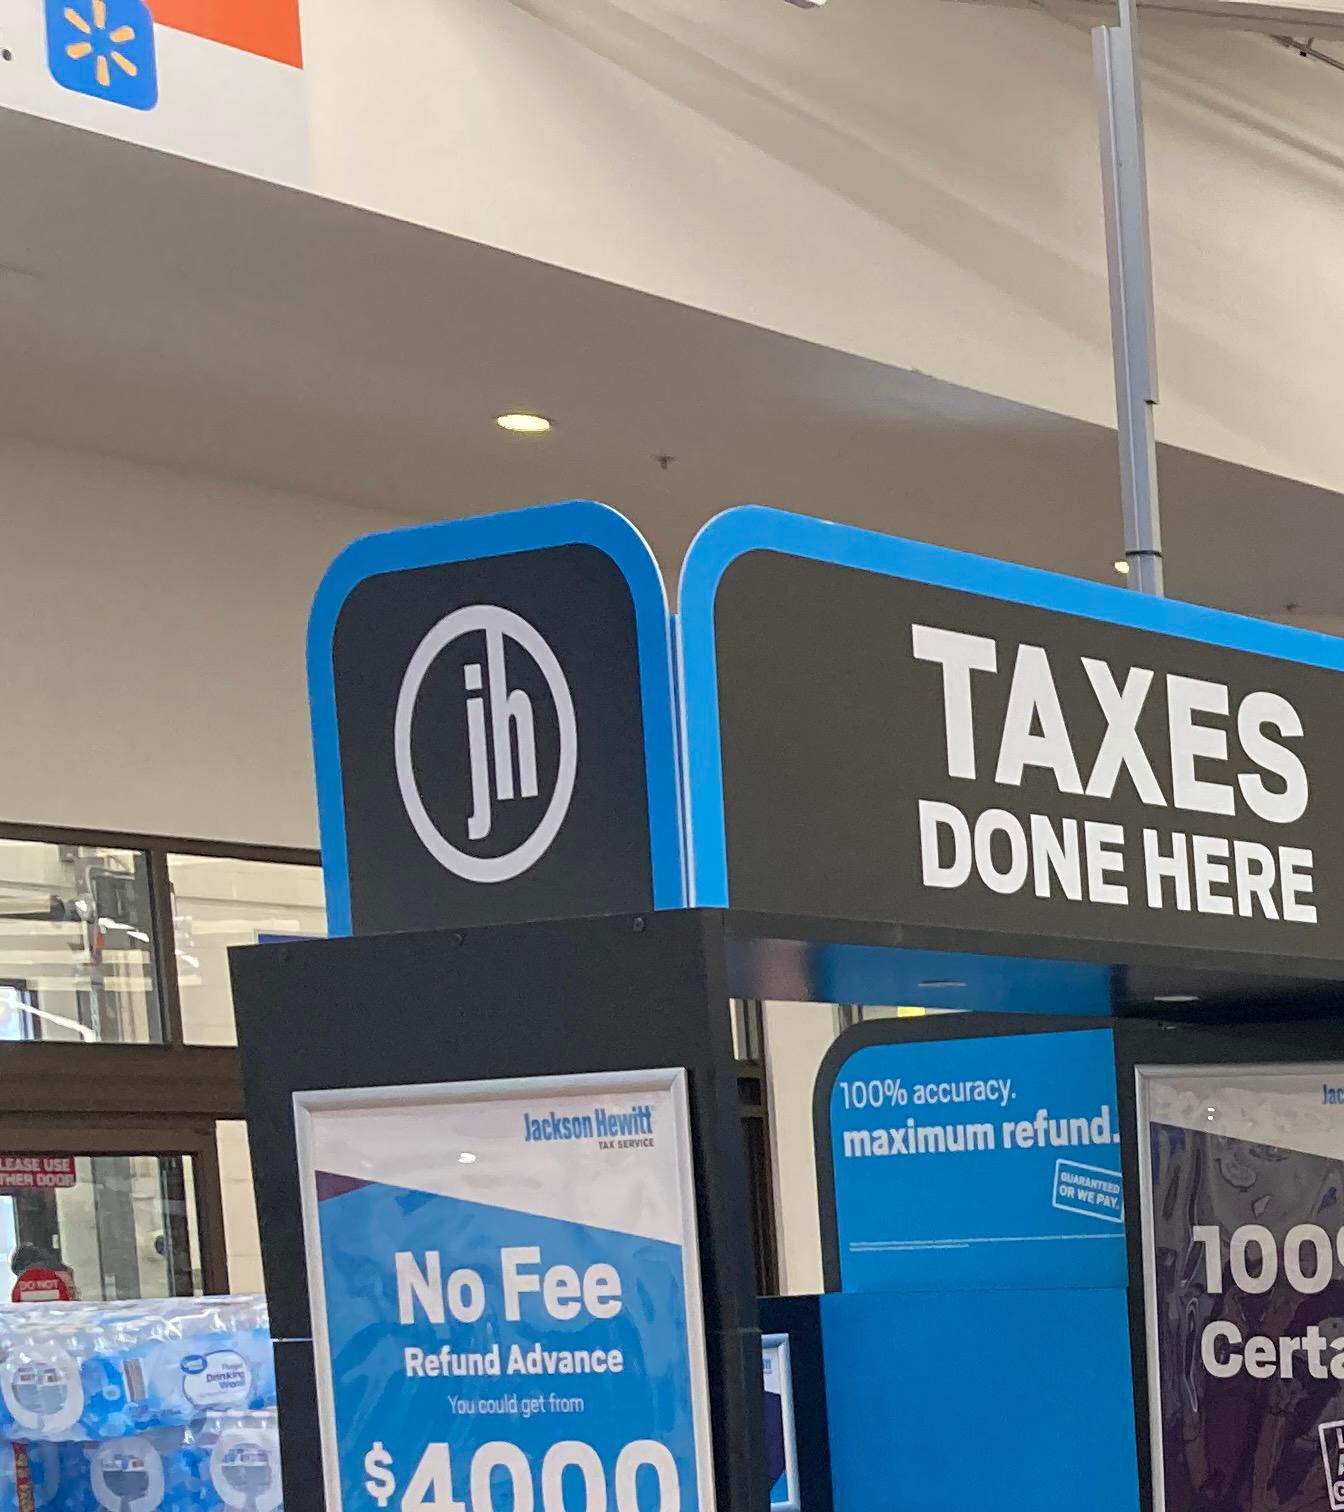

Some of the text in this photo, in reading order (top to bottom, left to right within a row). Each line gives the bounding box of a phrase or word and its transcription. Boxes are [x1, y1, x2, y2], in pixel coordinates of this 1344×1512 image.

[912, 623, 1308, 823] TAXES
[918, 799, 1318, 923] DONE HERE
[840, 1078, 1016, 1109] 100% accuracy.
[524, 1105, 653, 1142] Jackson Hewitt
[843, 1105, 1120, 1157] maximum refund.
[599, 1138, 655, 1150] TAX SERVICE
[0, 1158, 70, 1172] LEASE USE
[1059, 1185, 1075, 1199] OR
[1077, 1188, 1095, 1204] WE
[395, 1246, 623, 1325] No Fee
[404, 1343, 623, 1377] Refund Advance
[448, 1394, 584, 1418] You could get from
